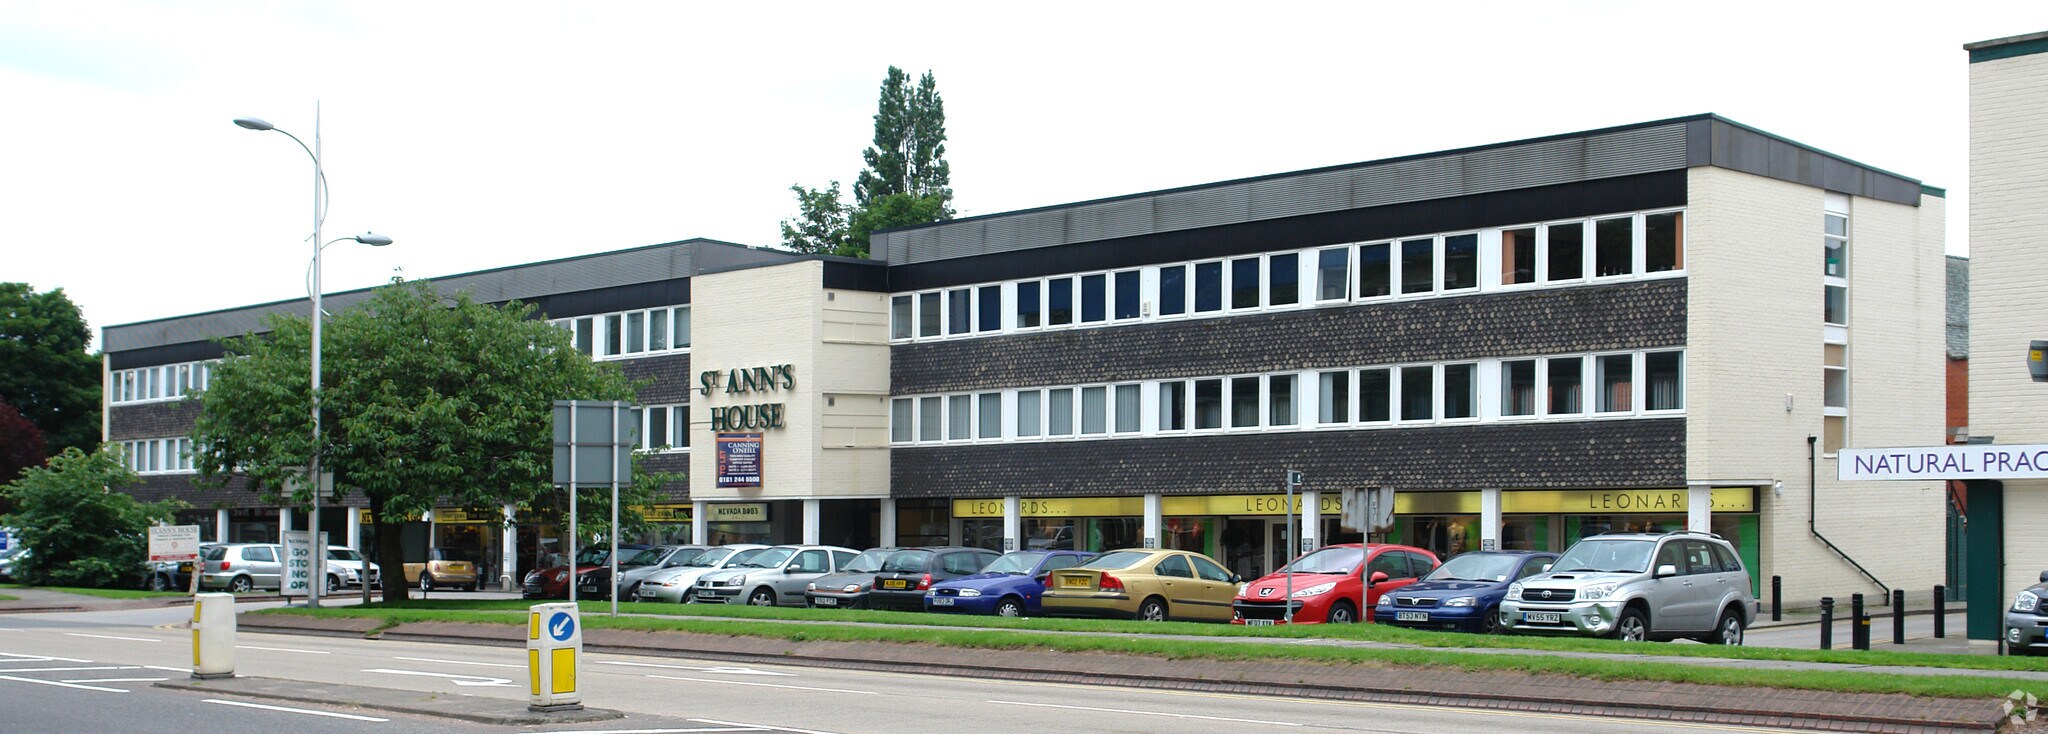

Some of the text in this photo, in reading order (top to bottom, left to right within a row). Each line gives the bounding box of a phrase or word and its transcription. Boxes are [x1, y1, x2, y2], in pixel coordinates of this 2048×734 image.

[726, 364, 796, 393] ANN'S
[710, 403, 785, 431] HOUSE
[719, 464, 726, 475] TO
[1855, 451, 2048, 474] NATURAL PRAC
